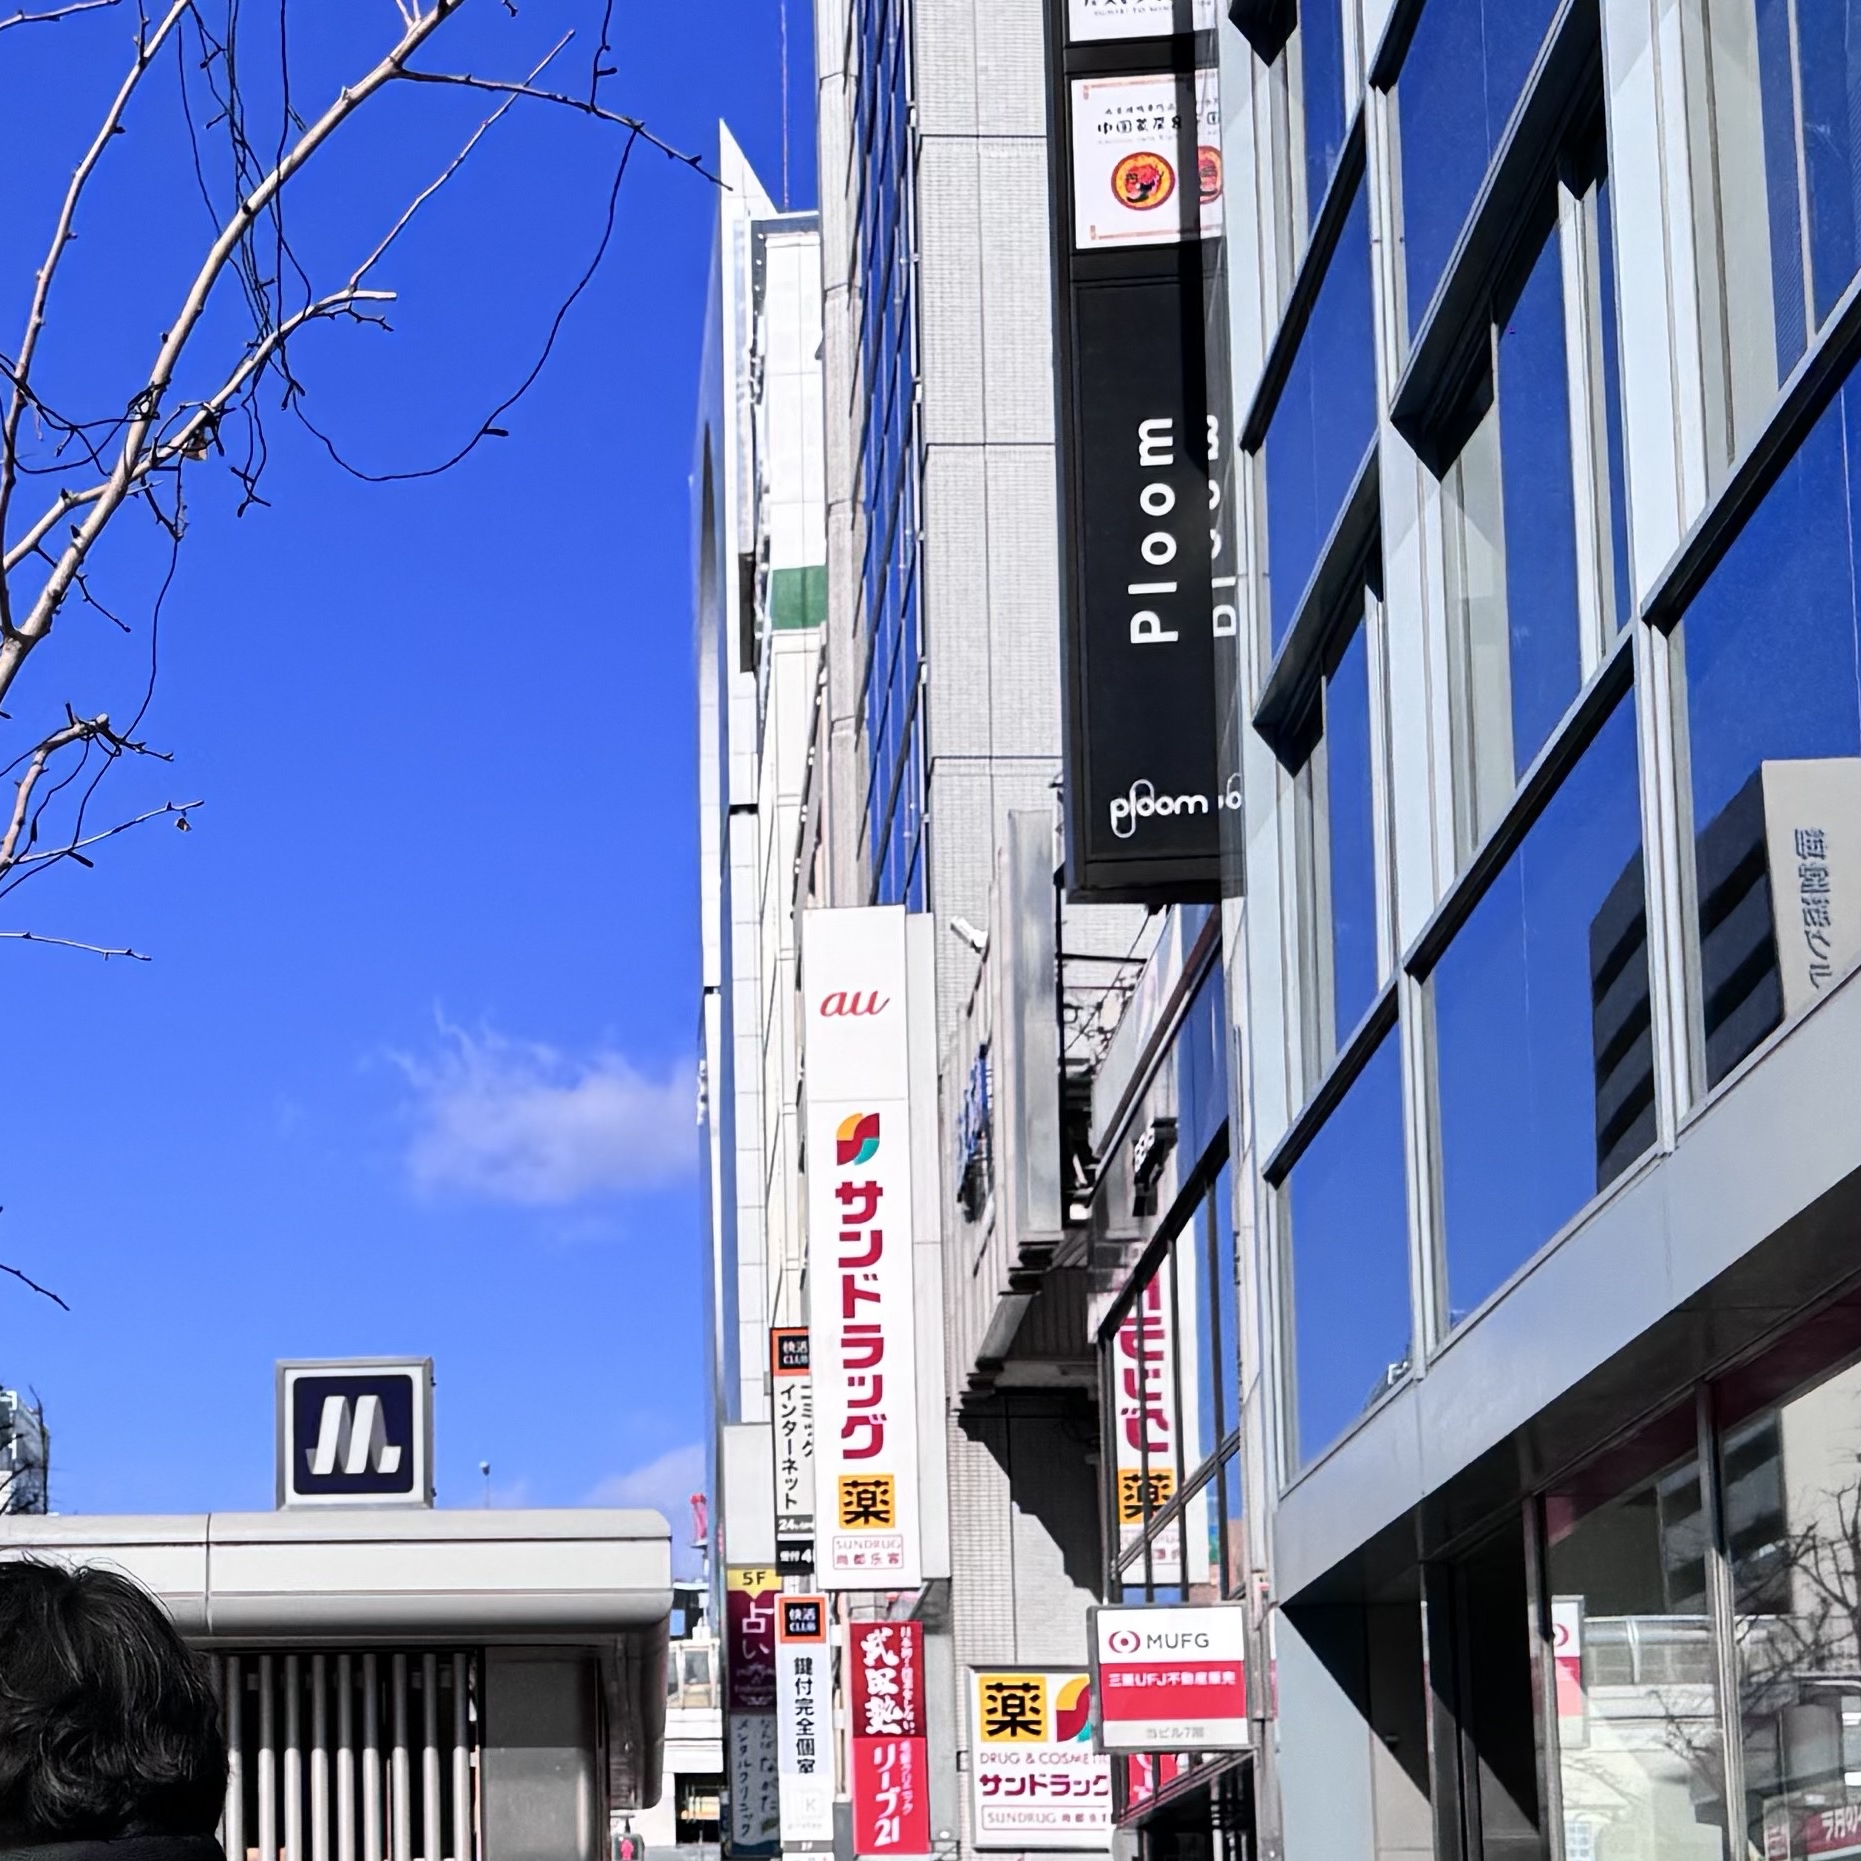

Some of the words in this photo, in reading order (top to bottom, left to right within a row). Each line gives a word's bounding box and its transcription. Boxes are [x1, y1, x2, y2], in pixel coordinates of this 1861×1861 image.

[1128, 417, 1179, 643] Ploom
[1111, 778, 1209, 838] ploom
[819, 989, 890, 1017] au
[835, 1180, 888, 1459] サンドラッグ
[780, 1383, 799, 1510] インターネット
[842, 1479, 891, 1525] 薬
[835, 1539, 902, 1551] SUNDRUG
[742, 1571, 766, 1585] 5F
[741, 1601, 775, 1660] 占い
[1147, 1633, 1210, 1649] MUFG
[860, 1626, 904, 1735] 武田塾
[985, 1682, 1043, 1737] 薬
[794, 1657, 816, 1774] 鍵付完全個室
[737, 1719, 753, 1837] メンタルクリニック
[980, 1752, 1020, 1765] DRUG
[1025, 1752, 1035, 1765] &
[873, 1743, 901, 1848] リーブ21
[988, 1812, 1057, 1824] SUNDRUG
